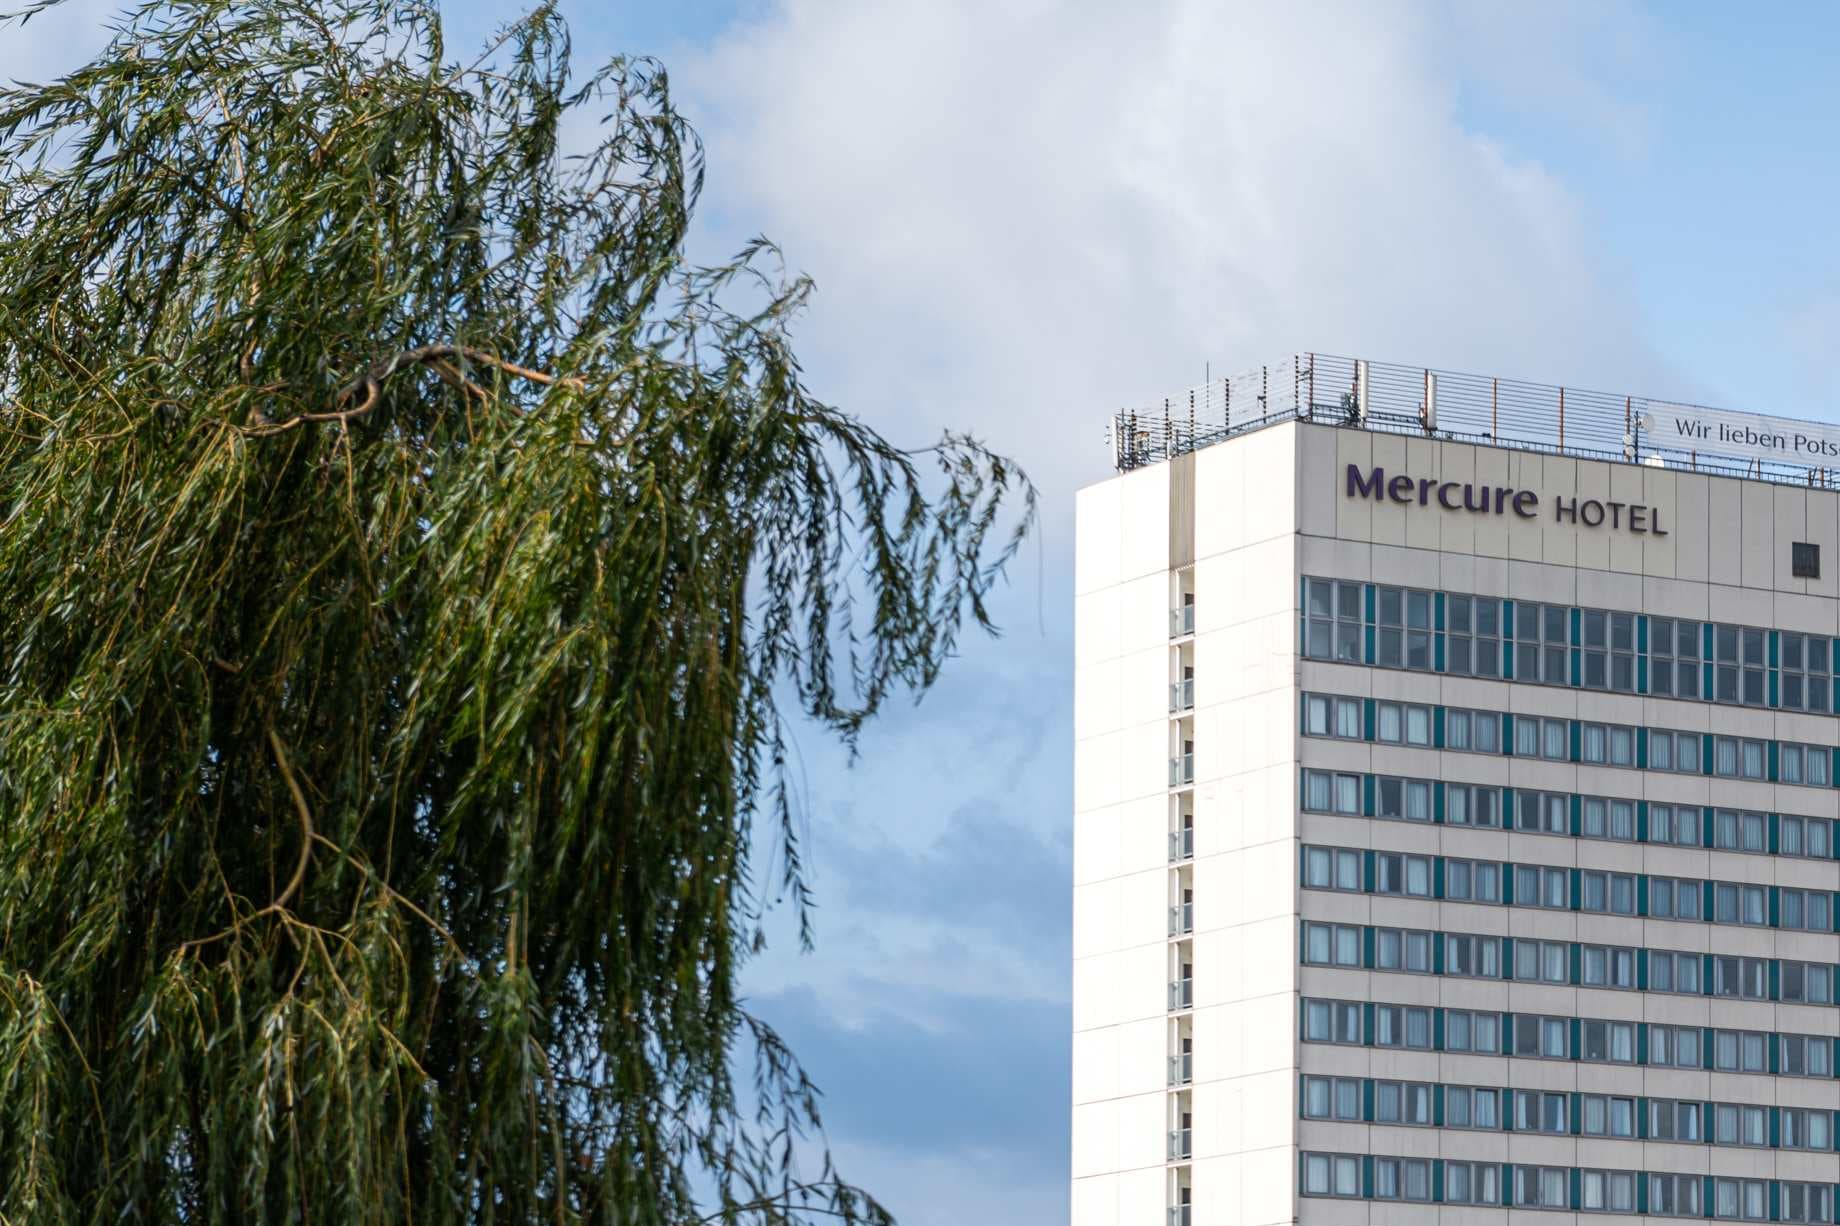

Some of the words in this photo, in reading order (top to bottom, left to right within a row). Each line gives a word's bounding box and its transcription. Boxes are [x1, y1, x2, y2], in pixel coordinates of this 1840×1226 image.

[1675, 418, 1712, 439] Wir
[1719, 423, 1785, 450] lieben
[1346, 463, 1539, 518] Mercure
[1556, 495, 1669, 536] HOTEL
